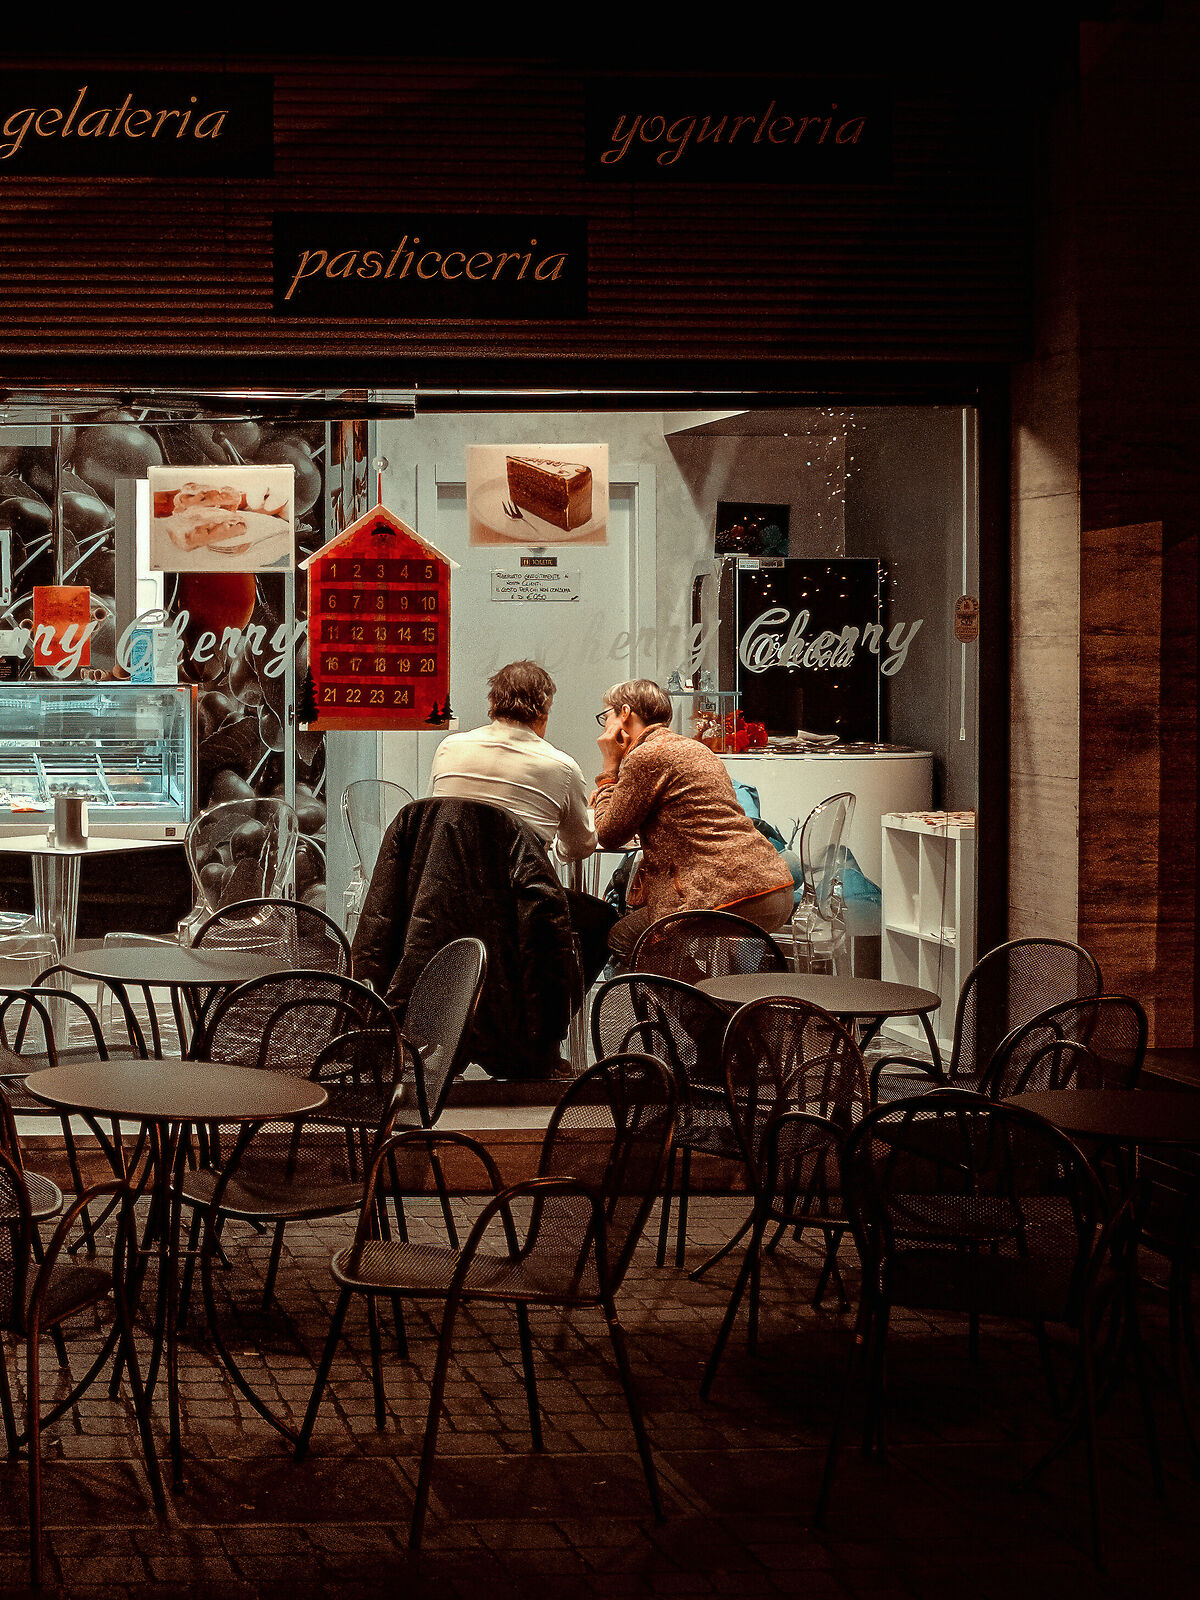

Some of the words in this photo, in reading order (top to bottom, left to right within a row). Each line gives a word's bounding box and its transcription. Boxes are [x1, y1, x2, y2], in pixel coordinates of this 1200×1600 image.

[600, 100, 869, 166] yogurteria
[284, 234, 569, 300] pasticceria
[331, 564, 336, 578] 1
[353, 565, 361, 577] 2
[377, 565, 384, 578] 3
[400, 565, 408, 579] 4
[425, 565, 432, 578] 5
[329, 595, 336, 608] 6
[353, 595, 360, 609] 7
[376, 596, 384, 610] 8
[401, 597, 408, 610] 9
[422, 597, 435, 610] 10
[116, 608, 309, 678] Cherry
[328, 626, 339, 640] 11
[351, 626, 363, 640] 12
[375, 627, 387, 640] 13
[398, 628, 411, 641] 14
[422, 628, 435, 642] 15
[538, 609, 722, 677] herry
[739, 607, 924, 676] Cherry
[326, 657, 338, 671] 16
[350, 658, 362, 671] 17
[374, 658, 386, 672] 18
[397, 659, 410, 672] 19
[420, 658, 434, 672] 20
[324, 688, 337, 702] 21
[346, 689, 361, 703] 22
[370, 689, 384, 703] 23
[394, 690, 408, 704] 24
